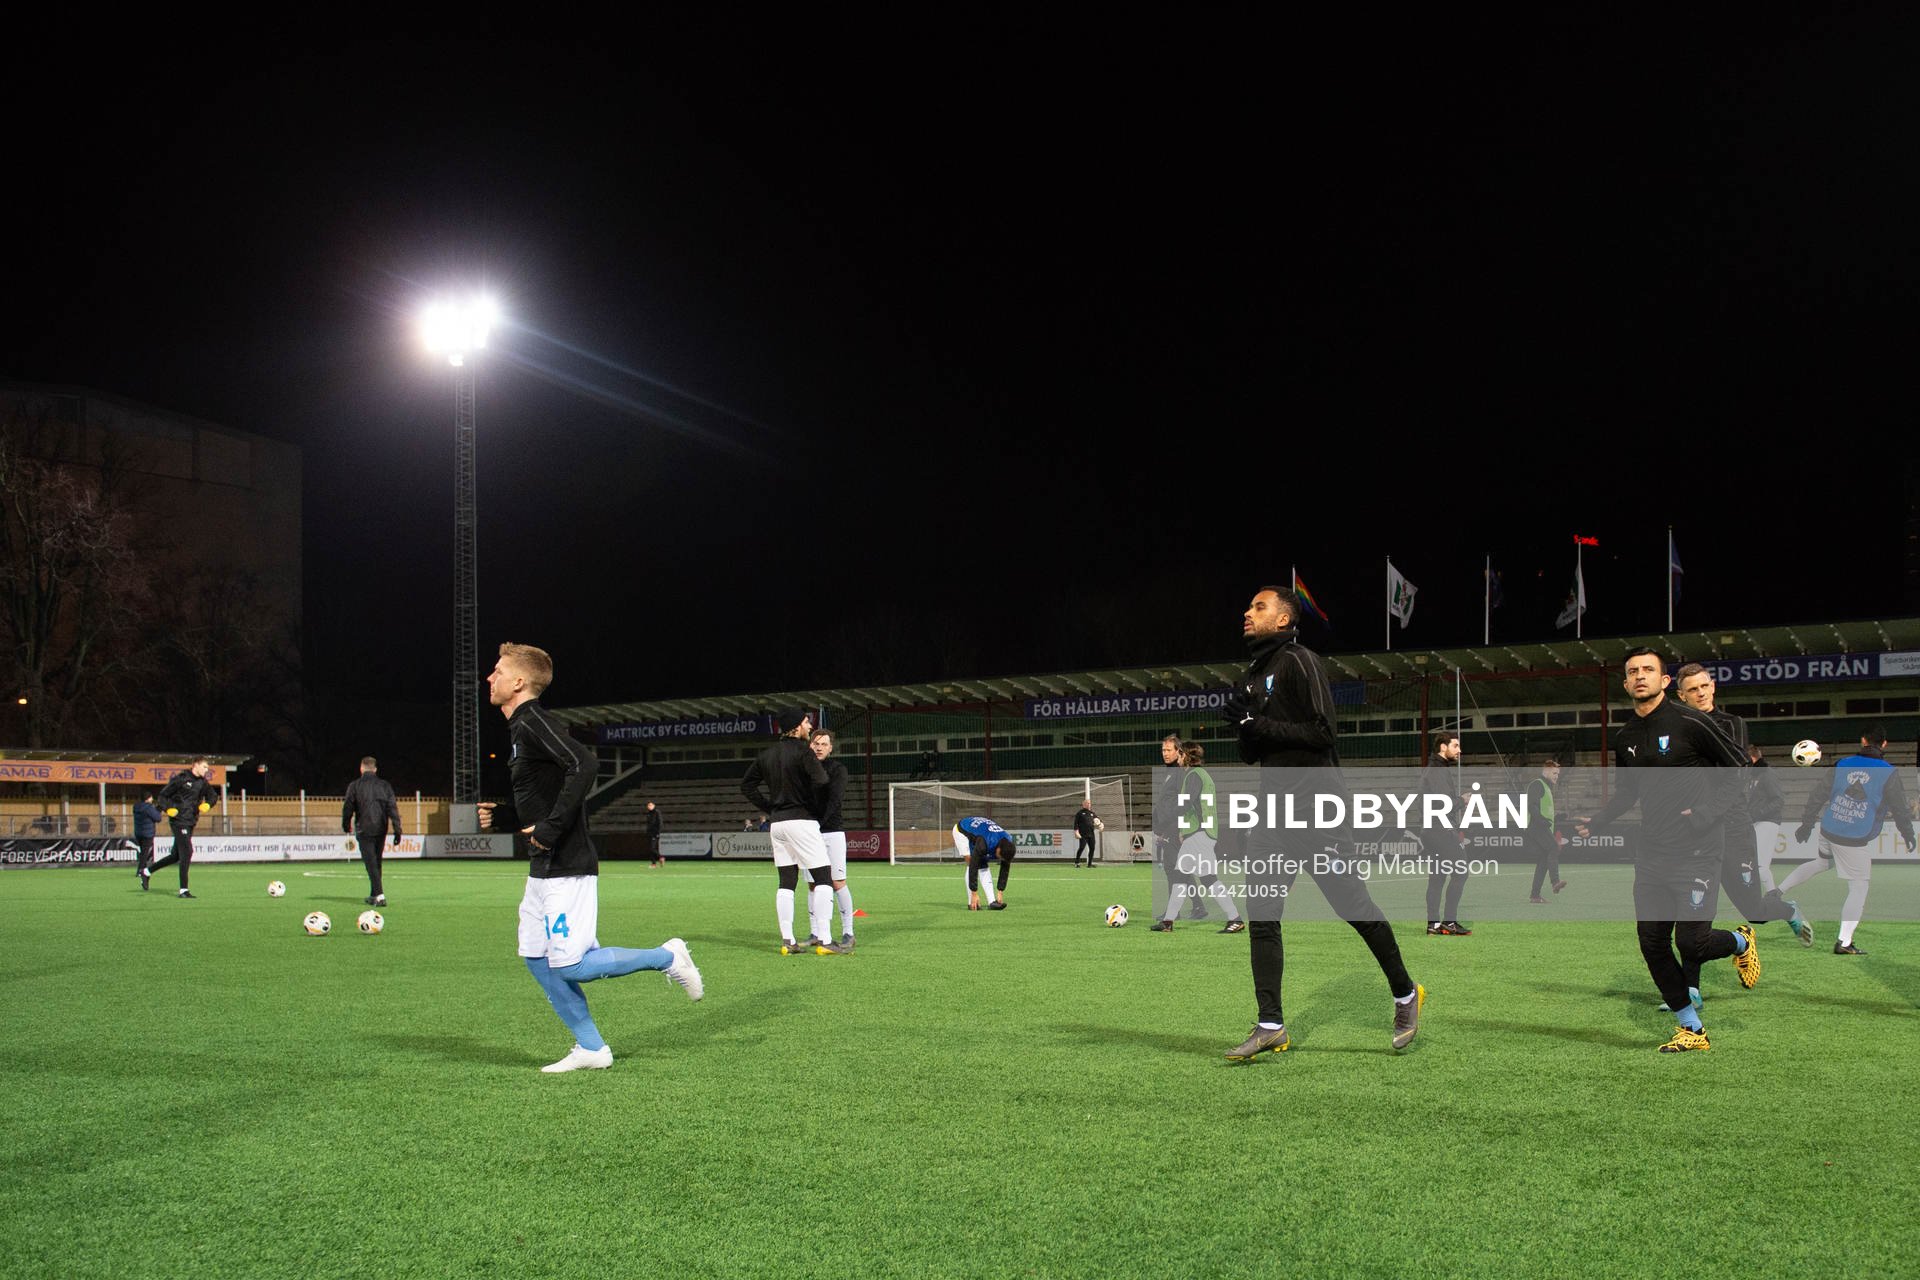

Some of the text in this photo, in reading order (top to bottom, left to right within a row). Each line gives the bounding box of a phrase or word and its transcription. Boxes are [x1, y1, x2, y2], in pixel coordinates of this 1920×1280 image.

[1709, 655, 1869, 682] ED STÖD FRÅN
[1033, 693, 1233, 717] FÖR HÅLLBAR TJEJFOTBOL
[607, 719, 757, 740] HATTRICK BY FC ROSENGÅRD
[67, 766, 136, 780] TEAMAB
[445, 838, 492, 850] SWEROCK
[1011, 833, 1053, 846] EAB
[106, 849, 137, 861] PUMA
[1354, 842, 1418, 855] TER PUMA
[544, 912, 570, 940] 14
